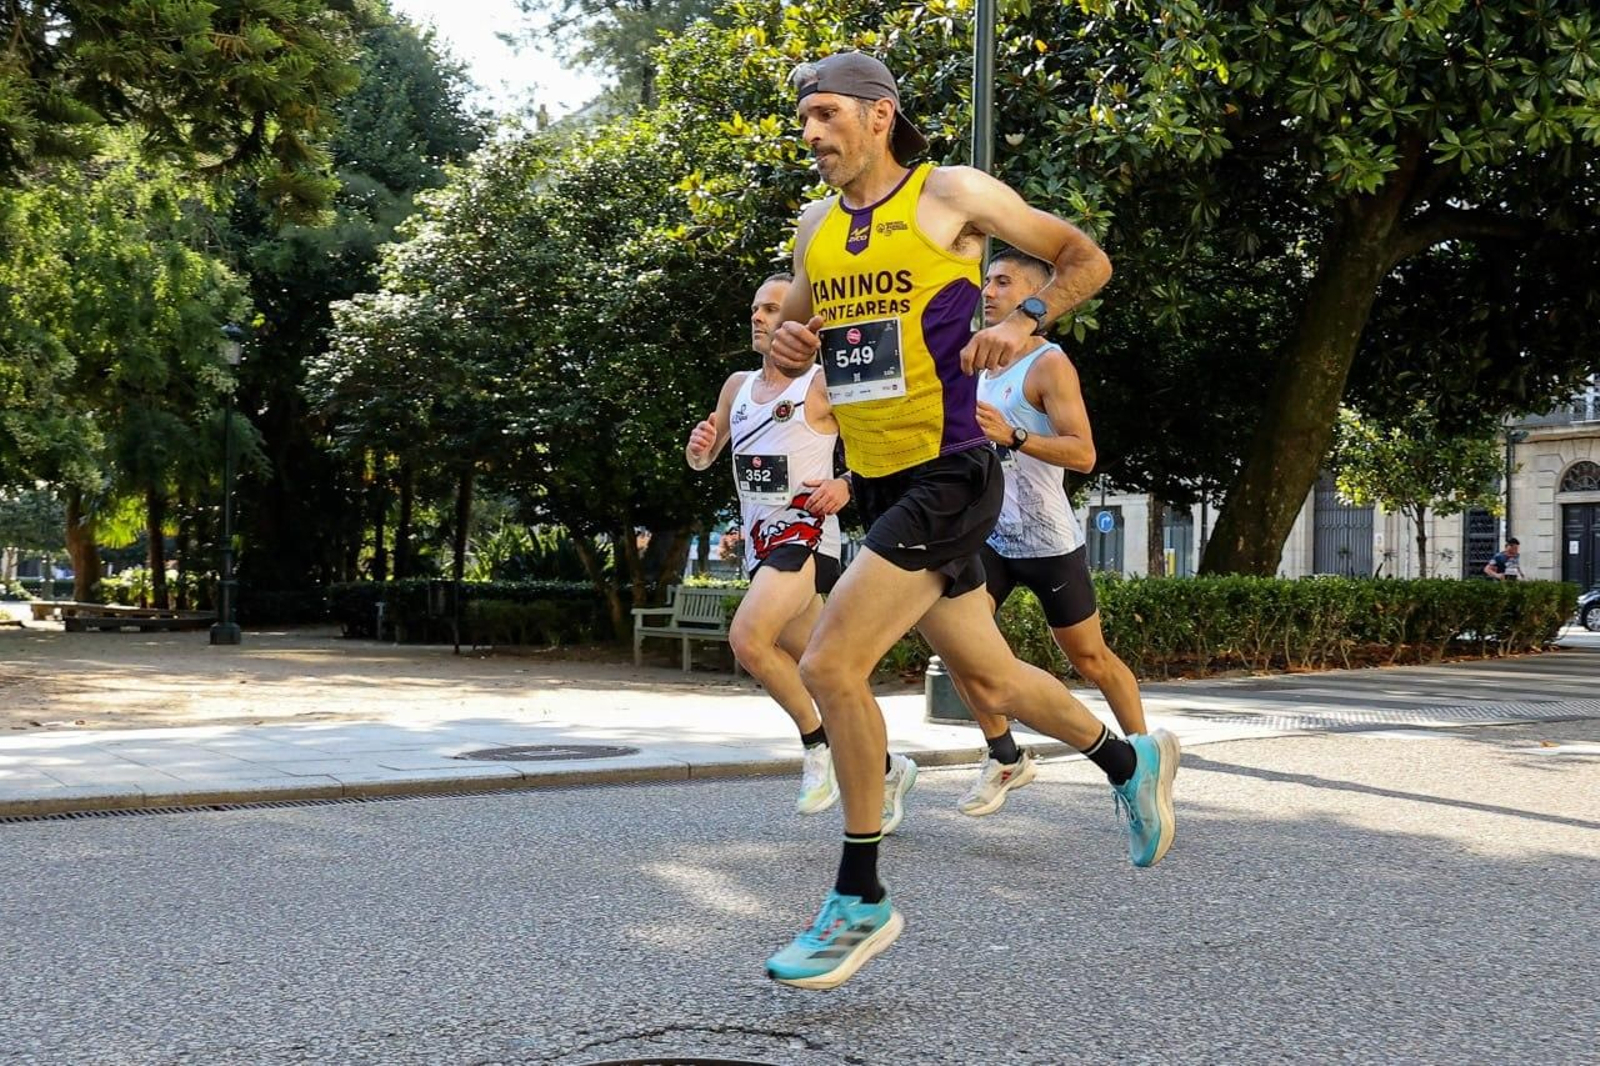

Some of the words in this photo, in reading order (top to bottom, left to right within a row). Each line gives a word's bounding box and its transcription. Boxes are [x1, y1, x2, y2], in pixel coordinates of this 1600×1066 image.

[818, 298, 911, 321] ONTEAREAS
[835, 345, 874, 368] 549
[745, 469, 772, 482] 352
